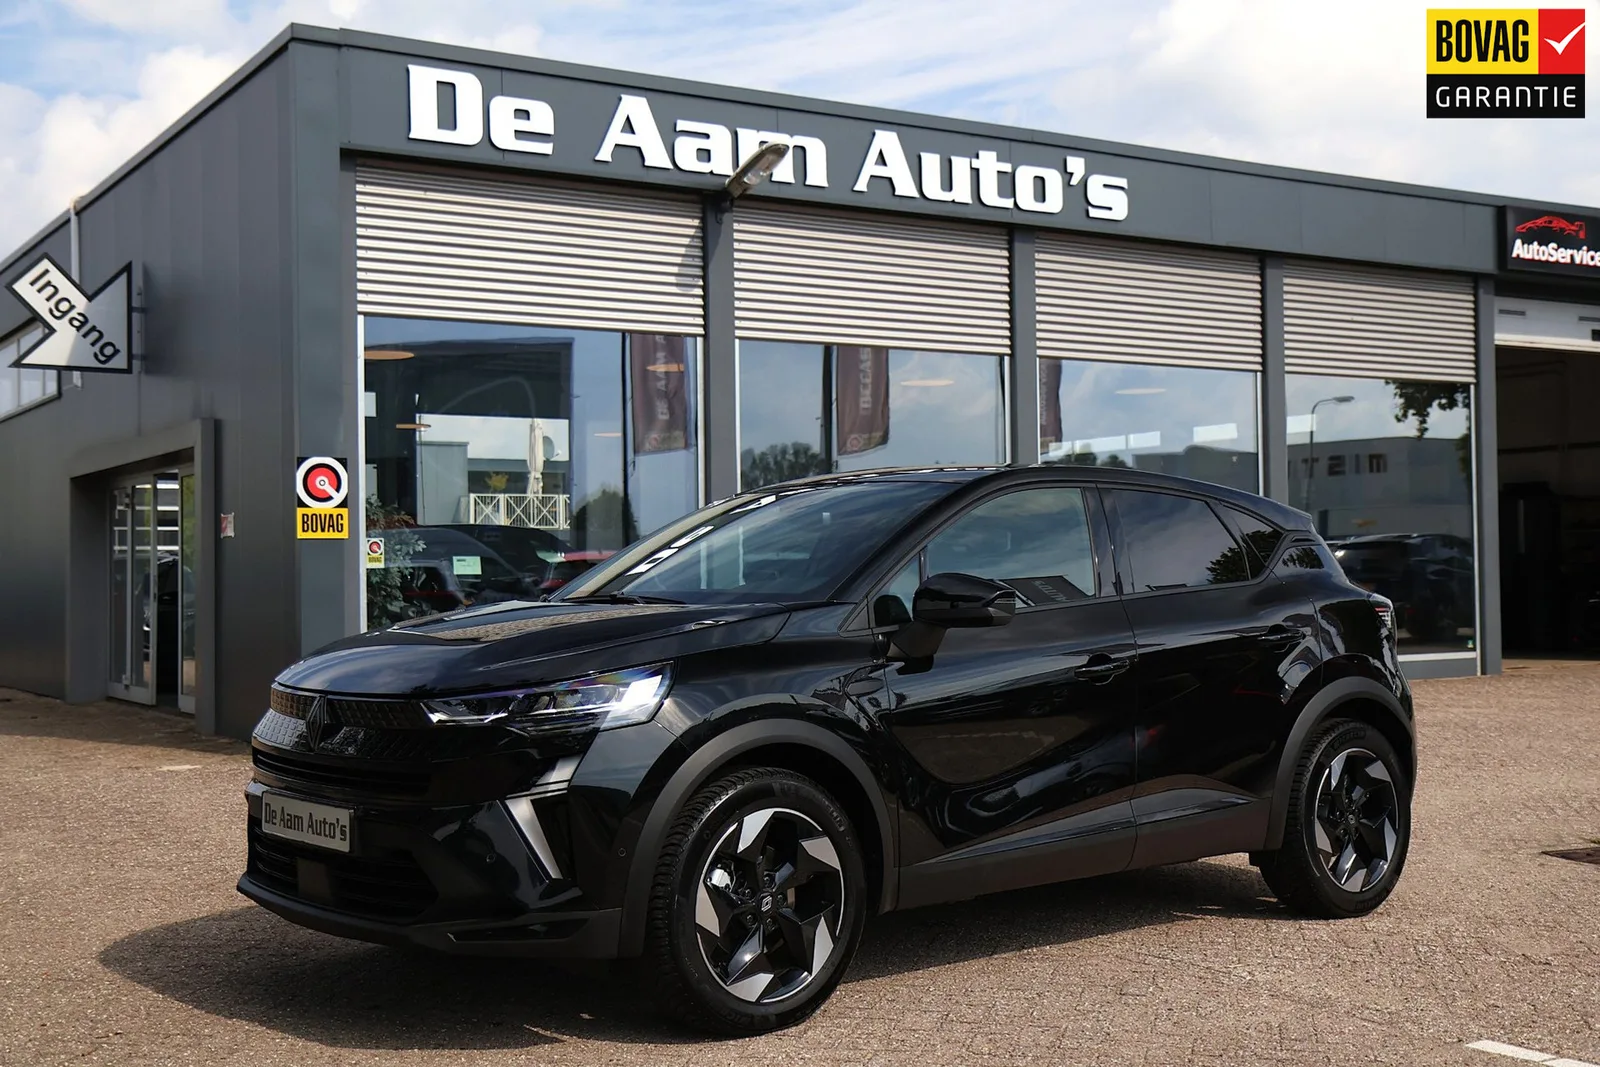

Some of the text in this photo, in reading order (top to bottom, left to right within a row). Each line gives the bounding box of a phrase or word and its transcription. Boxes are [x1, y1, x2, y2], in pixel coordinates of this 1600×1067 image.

[407, 63, 1129, 221] De Aam Auto's
[1511, 238, 1600, 267] AutoService
[28, 268, 121, 365] Ingang
[301, 513, 344, 533] BOVAG
[264, 802, 347, 841] De Aam Auto's
